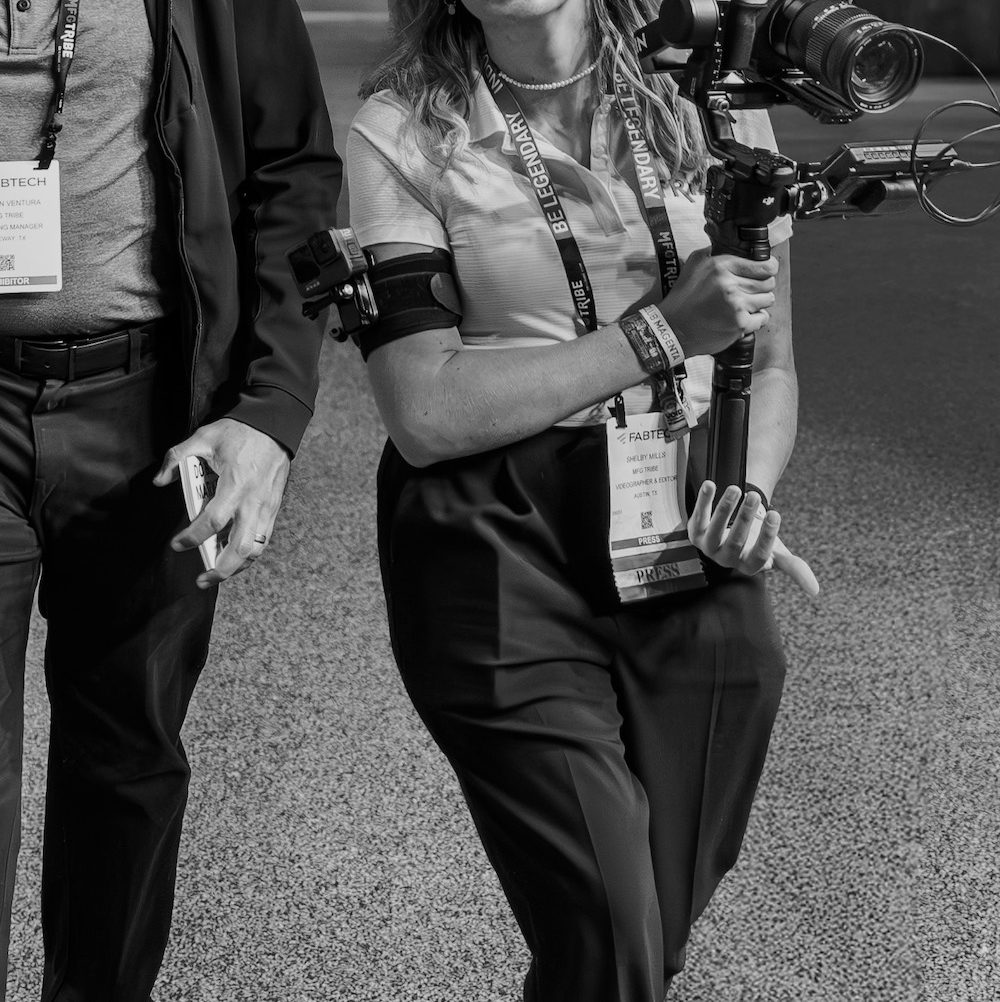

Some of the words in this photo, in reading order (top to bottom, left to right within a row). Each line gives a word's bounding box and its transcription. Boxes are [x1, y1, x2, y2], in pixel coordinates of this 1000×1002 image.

[505, 111, 559, 208] LEGENDARY
[6, 199, 42, 207] VENTURA
[547, 209, 569, 234] BE
[653, 319, 681, 361] MAGENTA
[626, 454, 648, 463] SHELBY
[648, 451, 667, 460] MILLS
[632, 467, 645, 475] MFG
[644, 465, 659, 473] TRIBE
[615, 478, 654, 490] VIDEOGRAPHER
[658, 474, 678, 484] EDITOR
[638, 535, 661, 546] PRESS
[636, 562, 681, 583] PRESS
